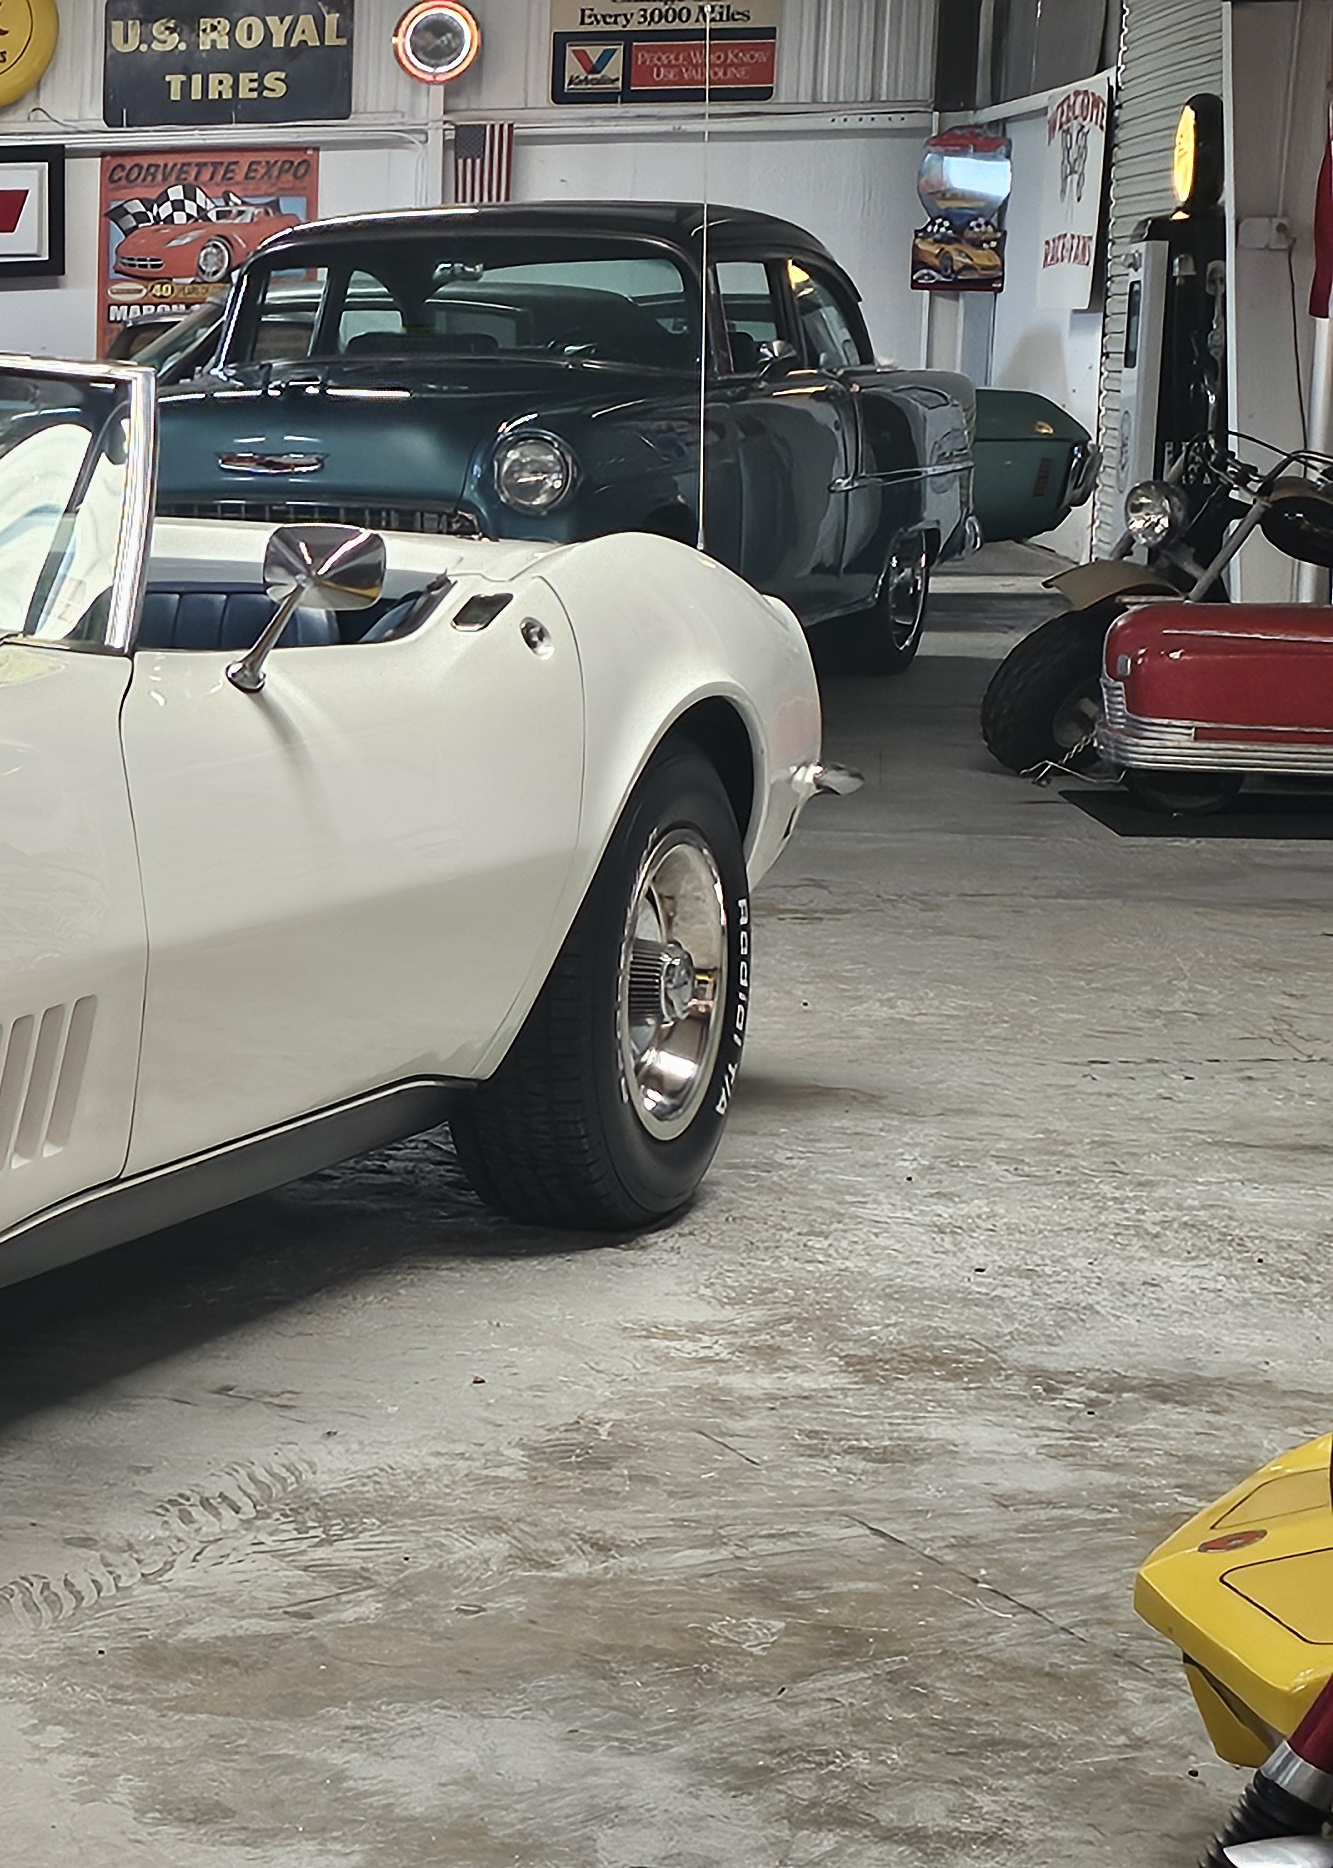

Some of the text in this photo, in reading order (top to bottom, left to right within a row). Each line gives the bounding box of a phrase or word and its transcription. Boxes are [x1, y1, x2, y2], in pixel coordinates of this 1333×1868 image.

[579, 8, 633, 28] Every
[637, 6, 691, 26] 3,000
[111, 13, 347, 52] U.S. ROYAL
[638, 52, 687, 66] PEOPLE
[727, 49, 768, 64] KNOW
[653, 66, 750, 80] USE VALOLINE
[165, 71, 287, 100] TIRES
[108, 159, 311, 184] CORVETTE EXPO
[152, 284, 172, 297] 40
[715, 898, 749, 1116] Radial T/A
